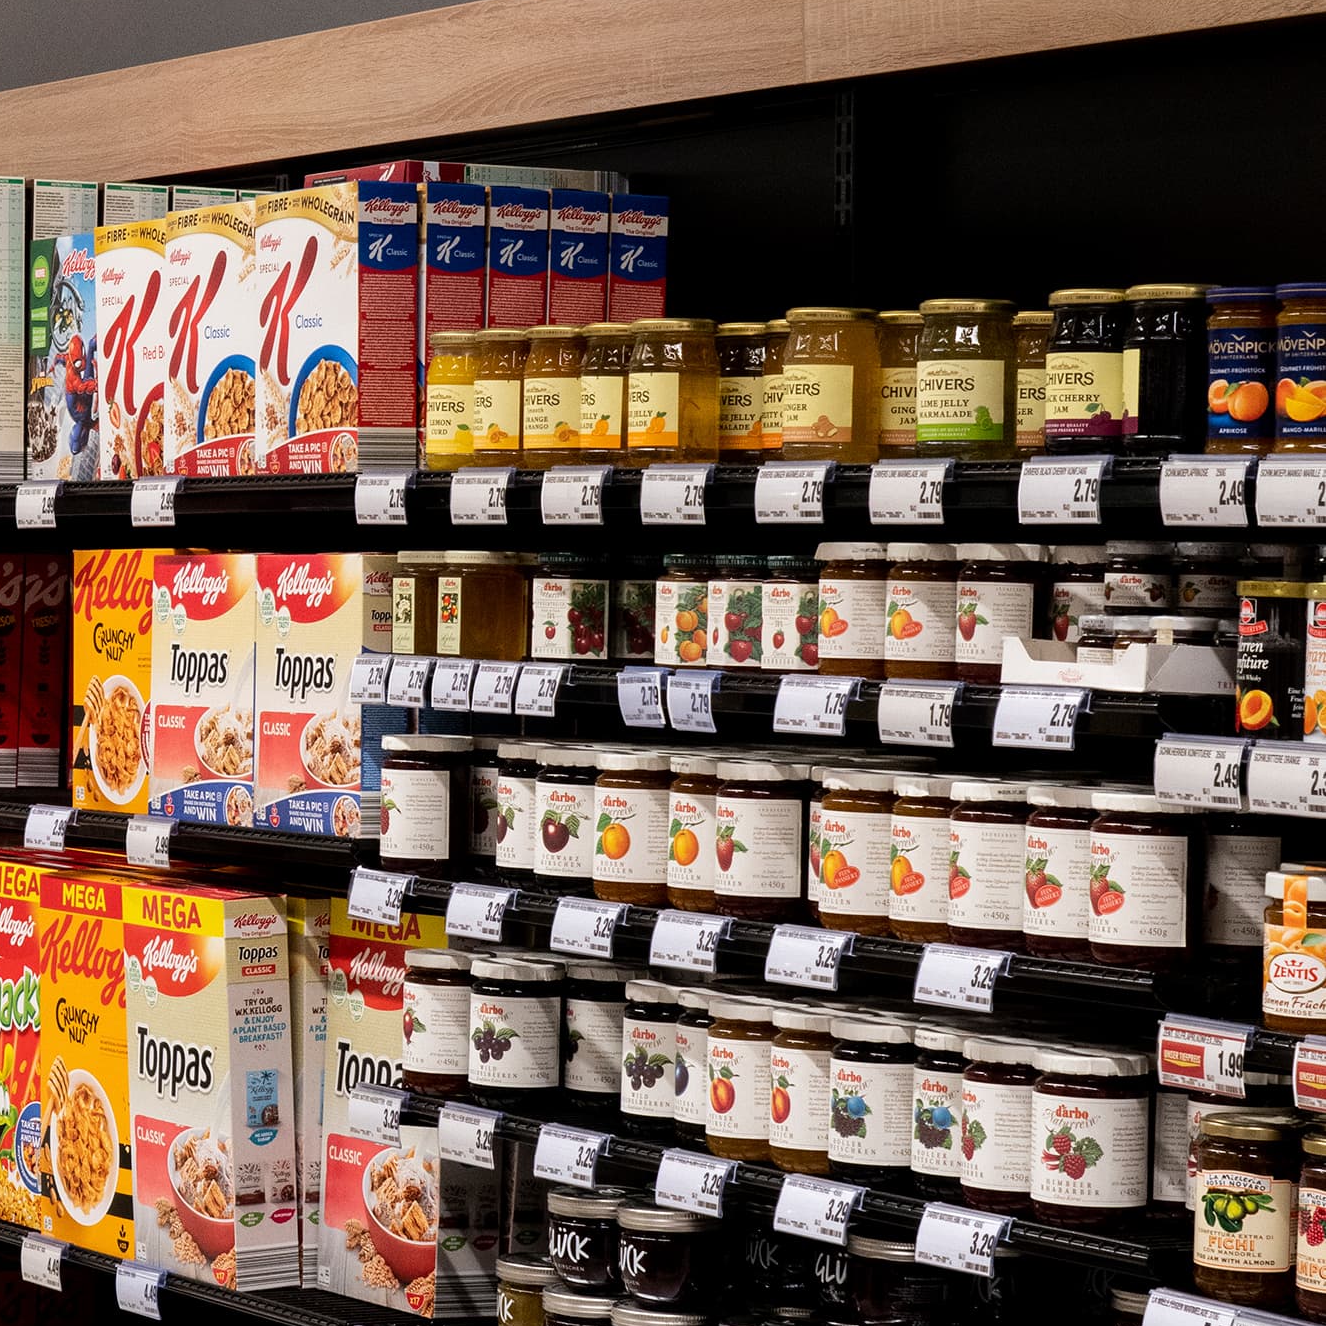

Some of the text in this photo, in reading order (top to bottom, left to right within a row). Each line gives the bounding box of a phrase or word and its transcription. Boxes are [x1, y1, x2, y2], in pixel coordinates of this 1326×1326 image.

[267, 196, 355, 225] FIBRE WHOLEGRAIN
[364, 198, 410, 215] Kellogg's
[433, 199, 478, 218] Kellogg's
[496, 204, 542, 222] Kellogg's
[617, 210, 664, 228] Kellogg's
[107, 226, 127, 243] FIBRE
[259, 235, 318, 386] SPECIAL K
[169, 250, 227, 394] SPECIAL K
[295, 313, 323, 329] Classic
[204, 325, 230, 340] Classic
[102, 270, 161, 416] SPECIAL K
[1208, 338, 1276, 354] MÖVENPICK
[142, 346, 157, 361] Red
[919, 377, 975, 392] CHIVERS
[1060, 393, 1100, 403] CHERRY
[919, 410, 973, 419] MARMALADE
[389, 489, 405, 508] 2.79
[581, 486, 600, 505] 2.79
[802, 481, 822, 503] 2.79
[1074, 479, 1098, 502] 2.79
[1219, 481, 1245, 506] 2.49
[173, 562, 229, 606] Kellogg's
[277, 562, 335, 608] Kellogg's
[93, 622, 136, 656] CRUNCHY
[105, 646, 125, 662] NUT
[170, 643, 229, 697] Toppas
[274, 646, 335, 703] Toppas
[158, 714, 186, 729] CLASSIC
[929, 703, 951, 727] 1.79
[1050, 703, 1075, 728] 2.79
[262, 721, 291, 737] CLASSIC
[1213, 762, 1239, 789] 2.49
[63, 882, 107, 911] MEGA
[385, 889, 402, 909] 3.29
[142, 894, 202, 930] MEGA
[594, 918, 613, 939] 3.29
[238, 944, 278, 963] Toppas
[816, 945, 839, 970] 3.29
[971, 964, 994, 990] 3.29
[1274, 962, 1318, 982] ZENTIS
[235, 1005, 282, 1016] W.K.KELLOGG
[244, 998, 274, 1007] TRY OUR
[1275, 1008, 1312, 1017] APRIKOSE
[55, 997, 100, 1035] CRUNCHY
[69, 1026, 87, 1046] NUT
[136, 1025, 212, 1100] Toppas
[1218, 1050, 1243, 1079] 1.99
[136, 1128, 166, 1147] CLASSIC
[476, 1130, 493, 1151] 3.29
[825, 1198, 848, 1223] 3.29
[970, 1232, 994, 1258] 3.29
[1208, 1235, 1256, 1252] FICHI
[1219, 1247, 1262, 1258] MANDORLE
